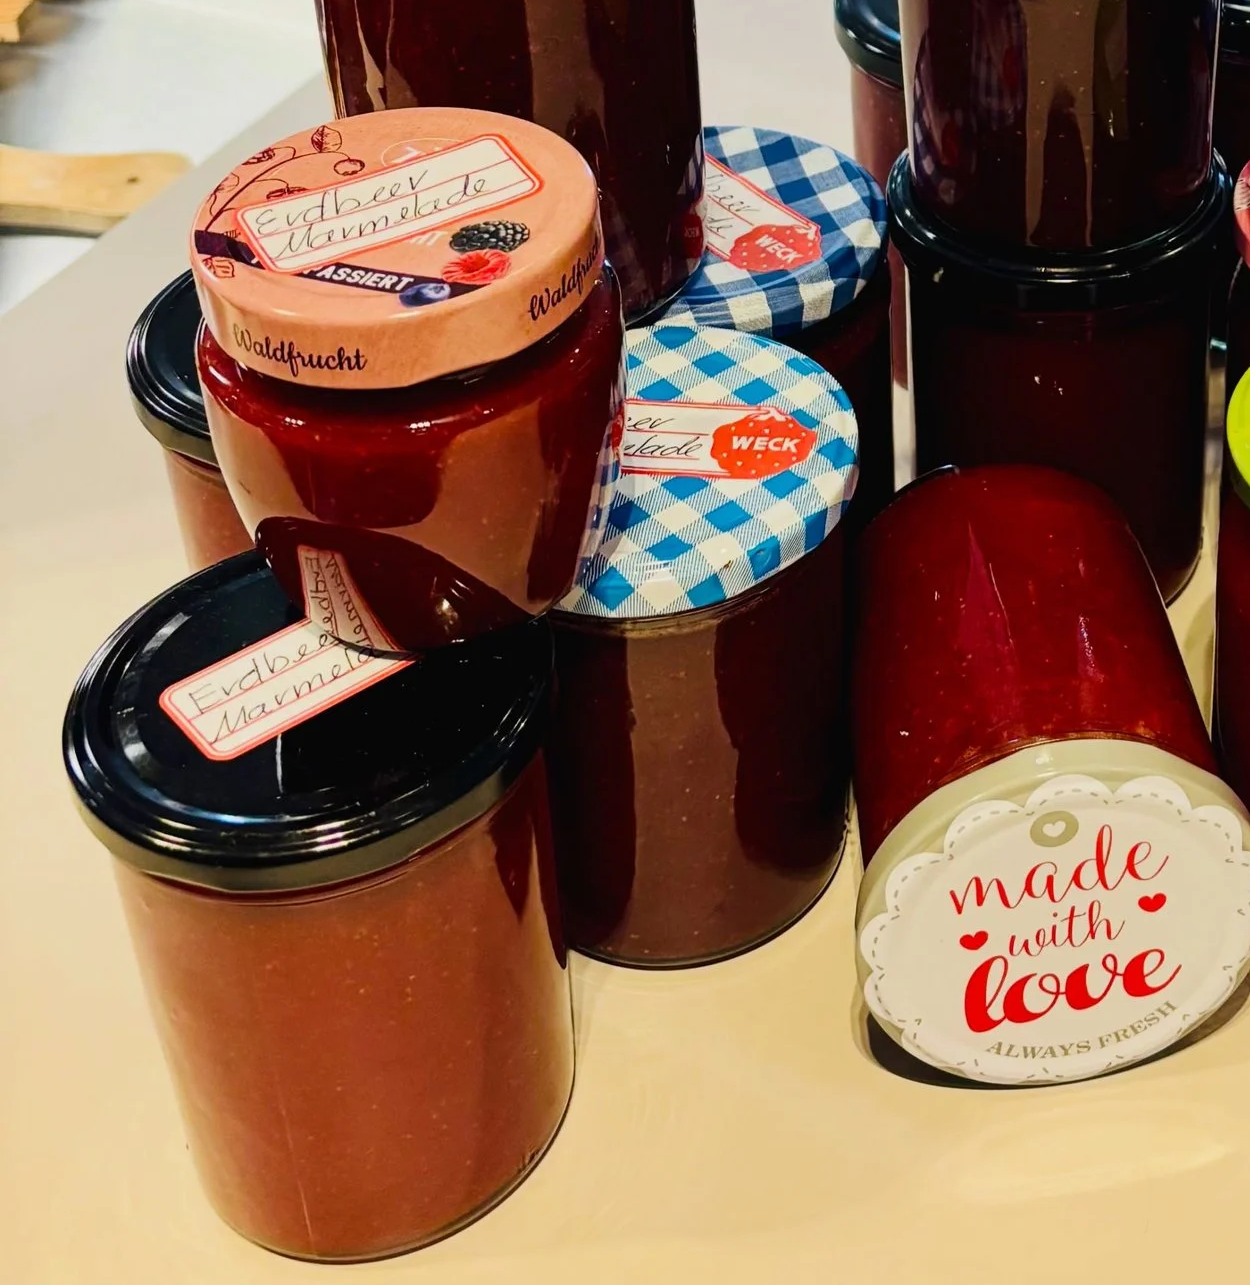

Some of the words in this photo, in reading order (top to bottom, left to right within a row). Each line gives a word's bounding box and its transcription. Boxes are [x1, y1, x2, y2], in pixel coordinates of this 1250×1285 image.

[255, 169, 429, 235] Erdbeer
[277, 174, 488, 259] Marmelade
[306, 265, 416, 293] ASSIERT
[755, 234, 804, 264] WECK
[233, 324, 368, 376] Waldfrucht
[731, 437, 800, 453] WECK
[189, 633, 336, 715] Erdbee
[209, 645, 378, 745] Marmela
[949, 824, 1170, 915] made
[1009, 900, 1126, 957] with
[964, 948, 1183, 1033] love
[986, 1040, 1092, 1059] ALWAYS
[1098, 1000, 1179, 1049] FRESH
